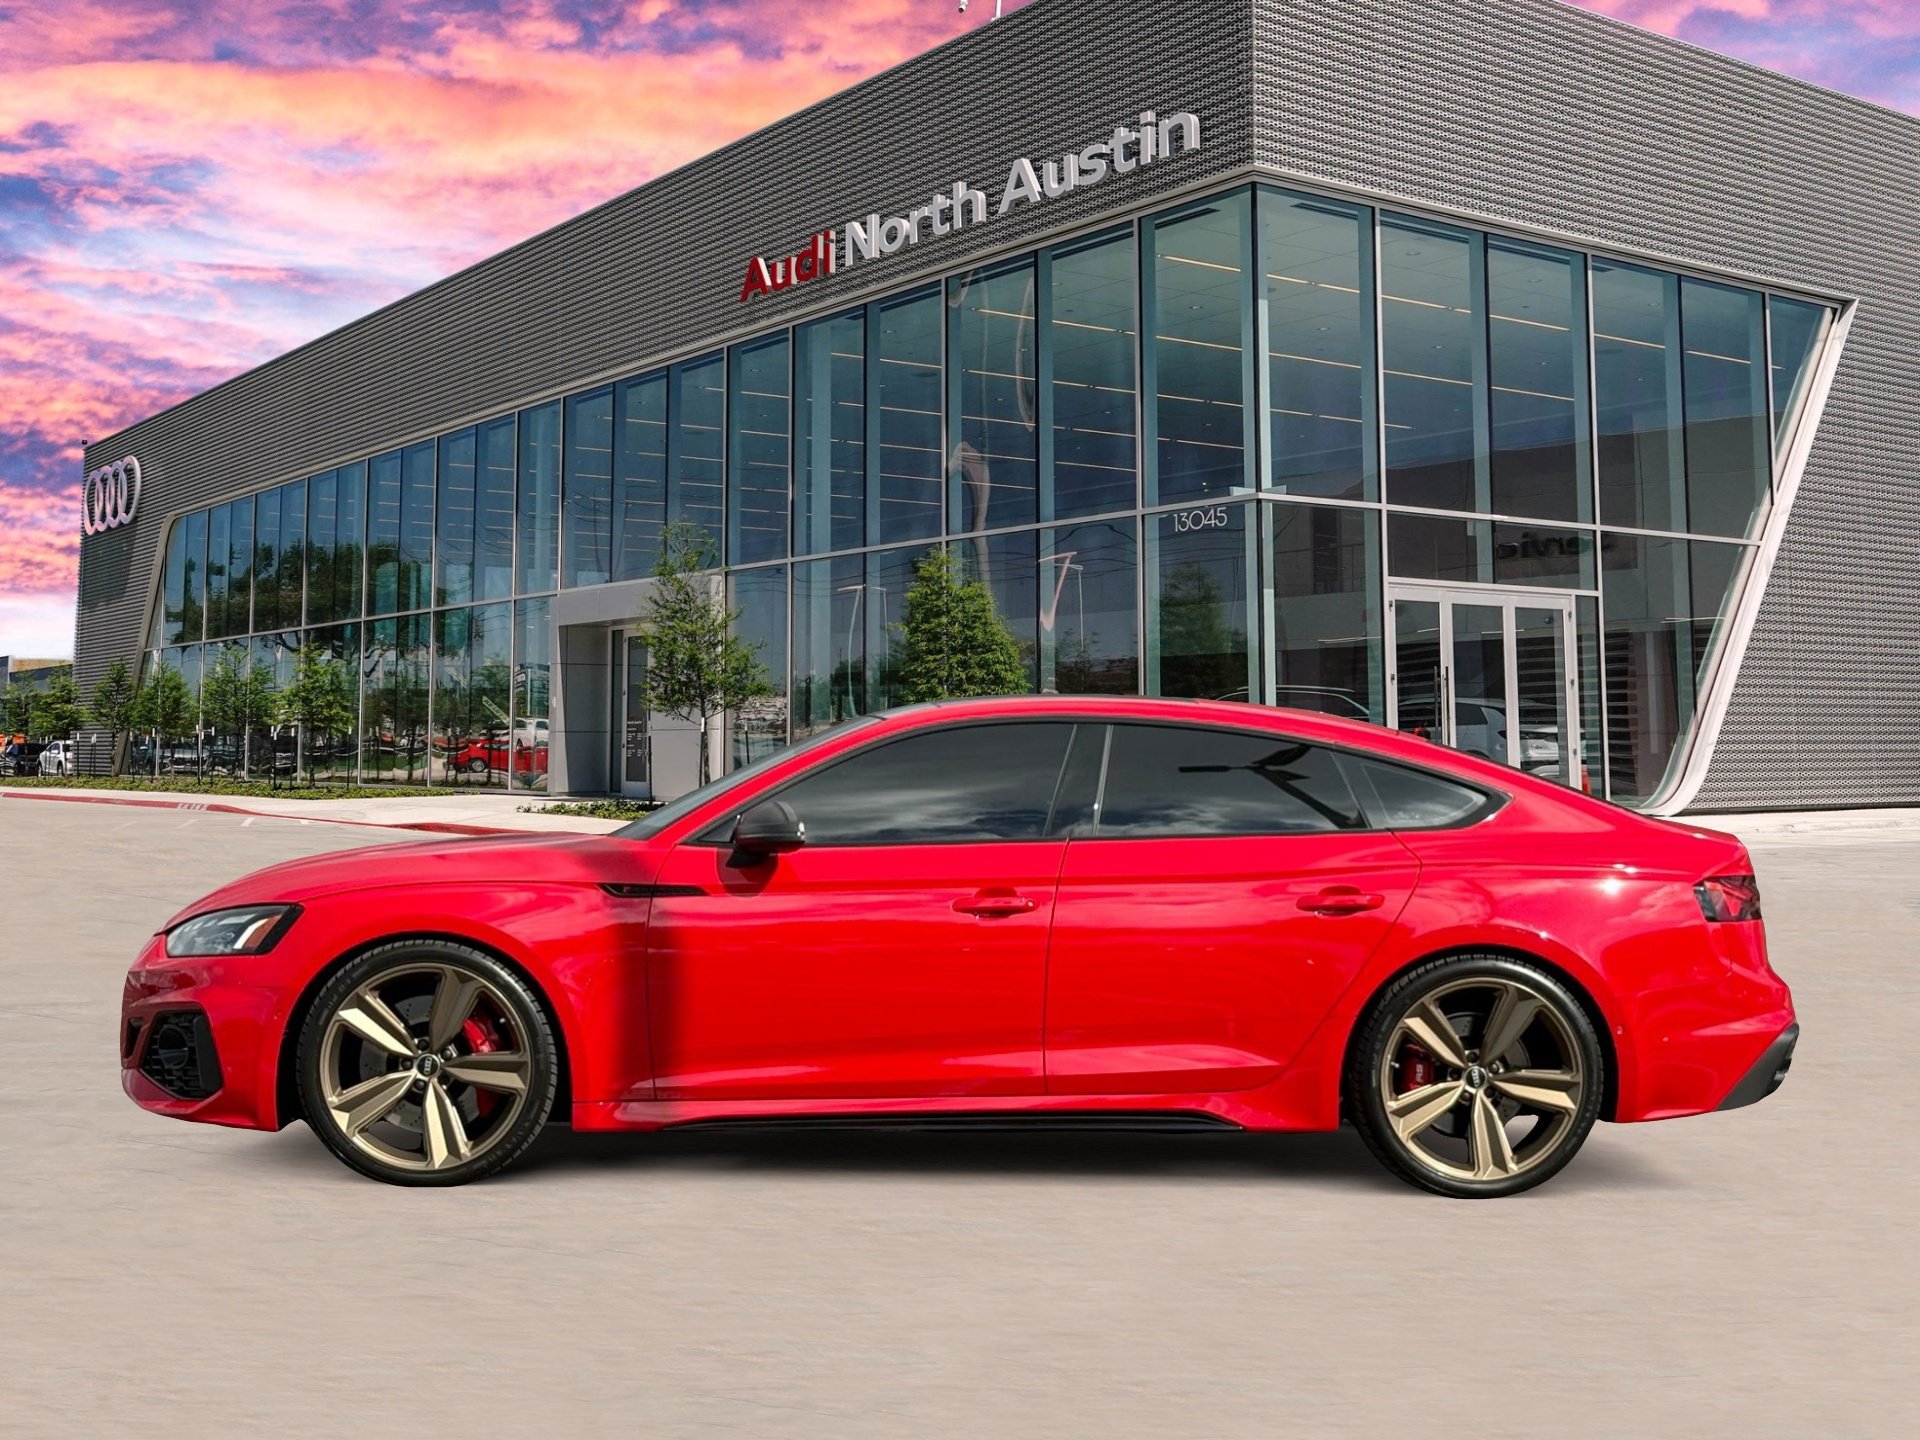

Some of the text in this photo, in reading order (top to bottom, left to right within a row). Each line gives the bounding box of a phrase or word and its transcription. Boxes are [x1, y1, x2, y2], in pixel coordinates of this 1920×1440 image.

[740, 110, 1200, 303] Audi North Austin
[1173, 506, 1228, 532] 13045
